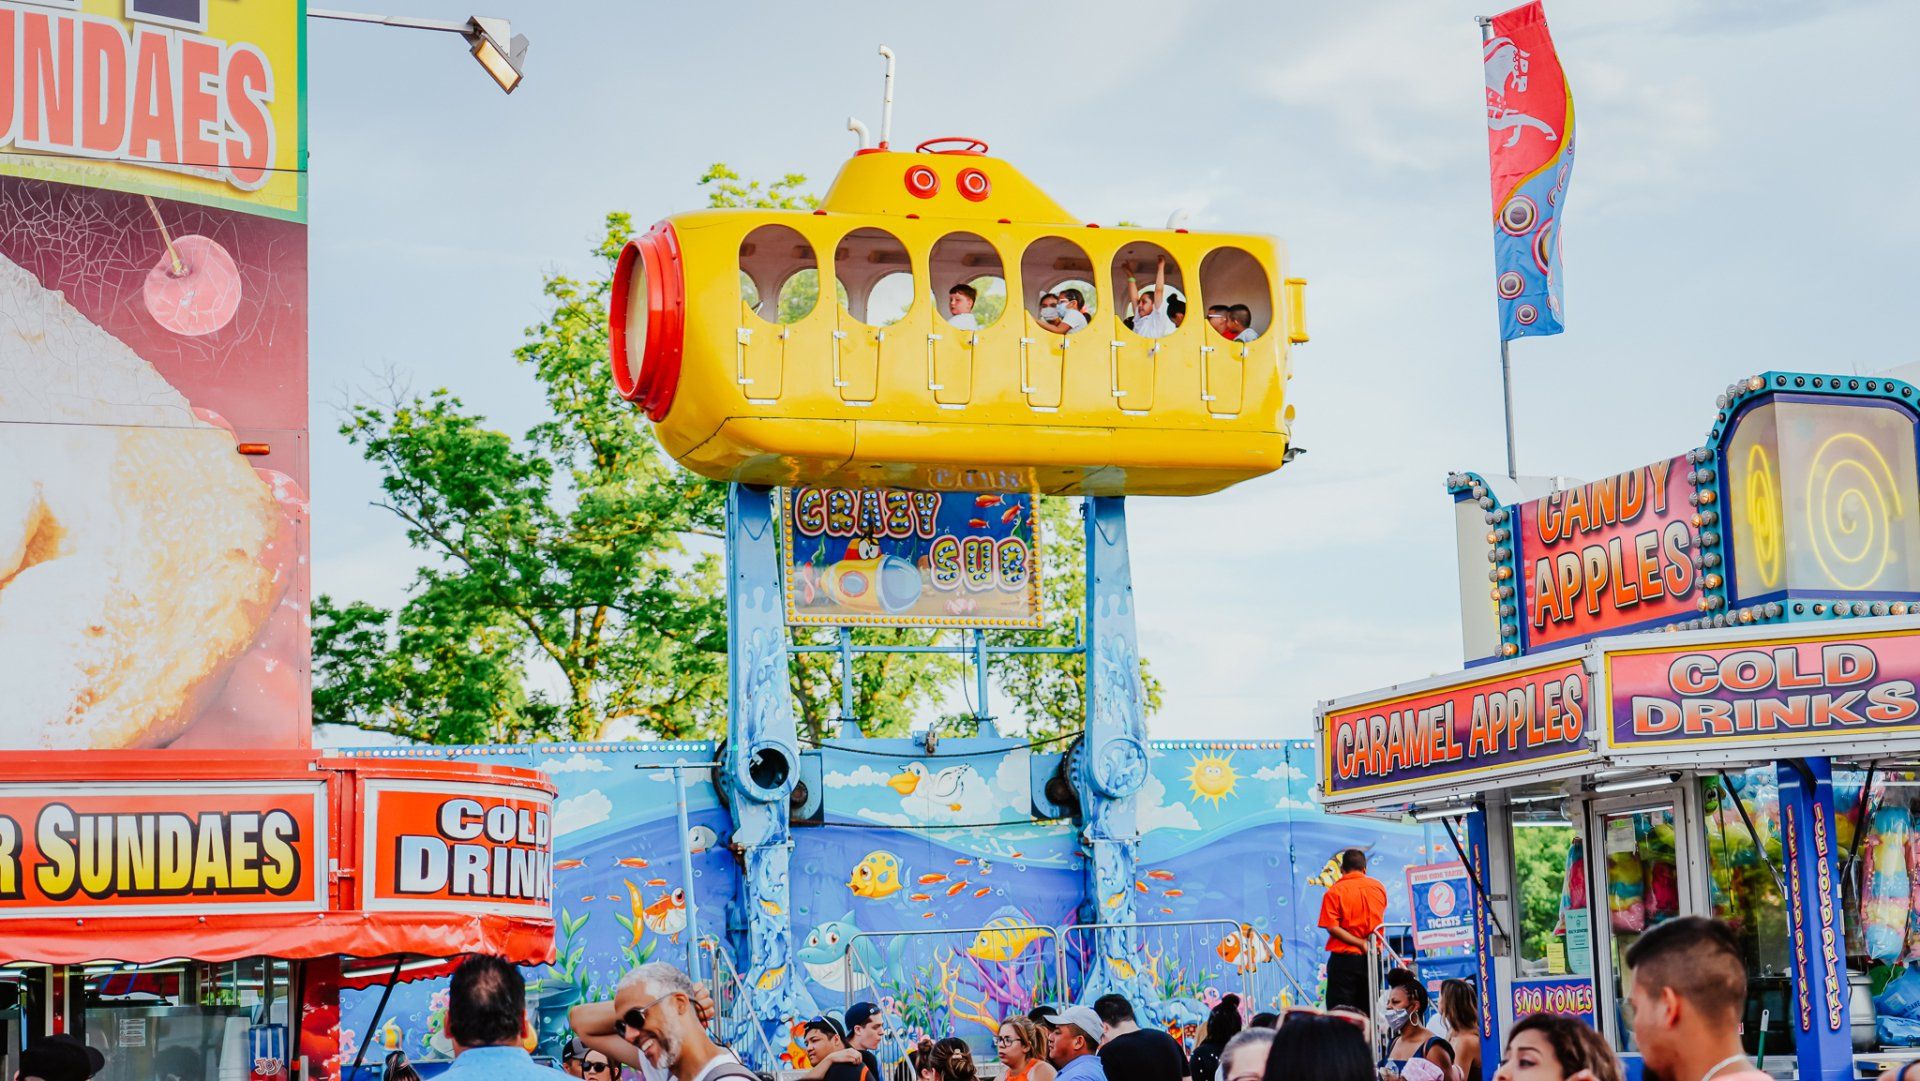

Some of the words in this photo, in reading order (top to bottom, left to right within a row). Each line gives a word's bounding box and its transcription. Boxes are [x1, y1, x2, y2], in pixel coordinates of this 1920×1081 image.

[795, 487, 941, 539] CRAZY
[1538, 459, 1672, 544] CANDY
[929, 535, 1029, 592] SUB
[1535, 520, 1694, 627] APPLES
[1669, 644, 1877, 696] COLD
[1337, 700, 1463, 780] CARAMEL
[1469, 674, 1584, 758] APPLES
[1631, 680, 1919, 735] DRINKS
[436, 798, 550, 847] COLD
[1787, 804, 1797, 858] ICE
[1814, 802, 1828, 856] ICE
[35, 802, 300, 901] SUNDAES
[1434, 885, 1451, 912] 2
[1790, 858, 1803, 928] COLD
[1818, 857, 1833, 927] COLD
[1427, 916, 1461, 929] TICKETS
[1479, 950, 1491, 1037] DRINKS
[1514, 986, 1543, 1016] SNO
[1545, 984, 1593, 1015] KONES
[1795, 928, 1811, 1031] DRINKS
[1822, 927, 1843, 1030] DRINKS
[254, 1057, 283, 1076] JOY
